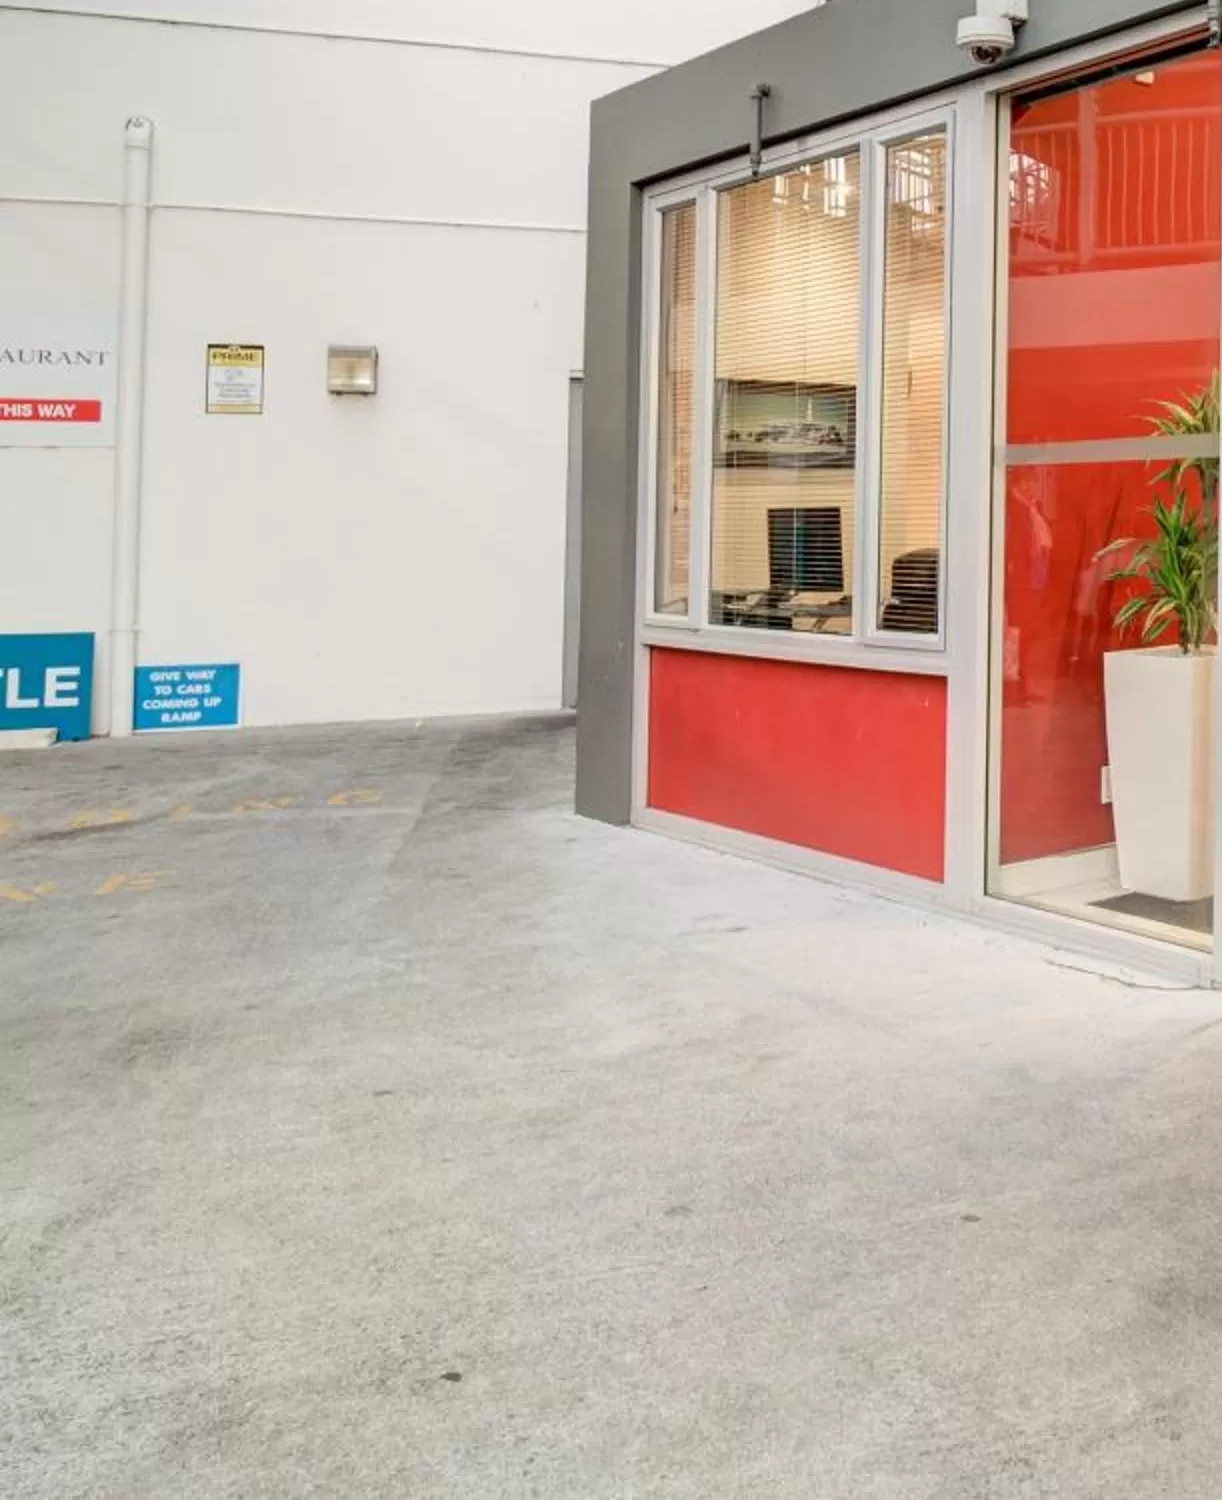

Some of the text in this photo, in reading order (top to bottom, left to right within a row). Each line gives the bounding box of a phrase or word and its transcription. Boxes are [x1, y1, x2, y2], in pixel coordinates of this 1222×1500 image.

[38, 403, 76, 419] WAY
[149, 669, 217, 682] GIVE WAY
[0, 666, 81, 709] LE
[153, 683, 212, 696] TO CARS
[142, 696, 222, 710] COMING UP
[161, 711, 202, 724] RAMP
